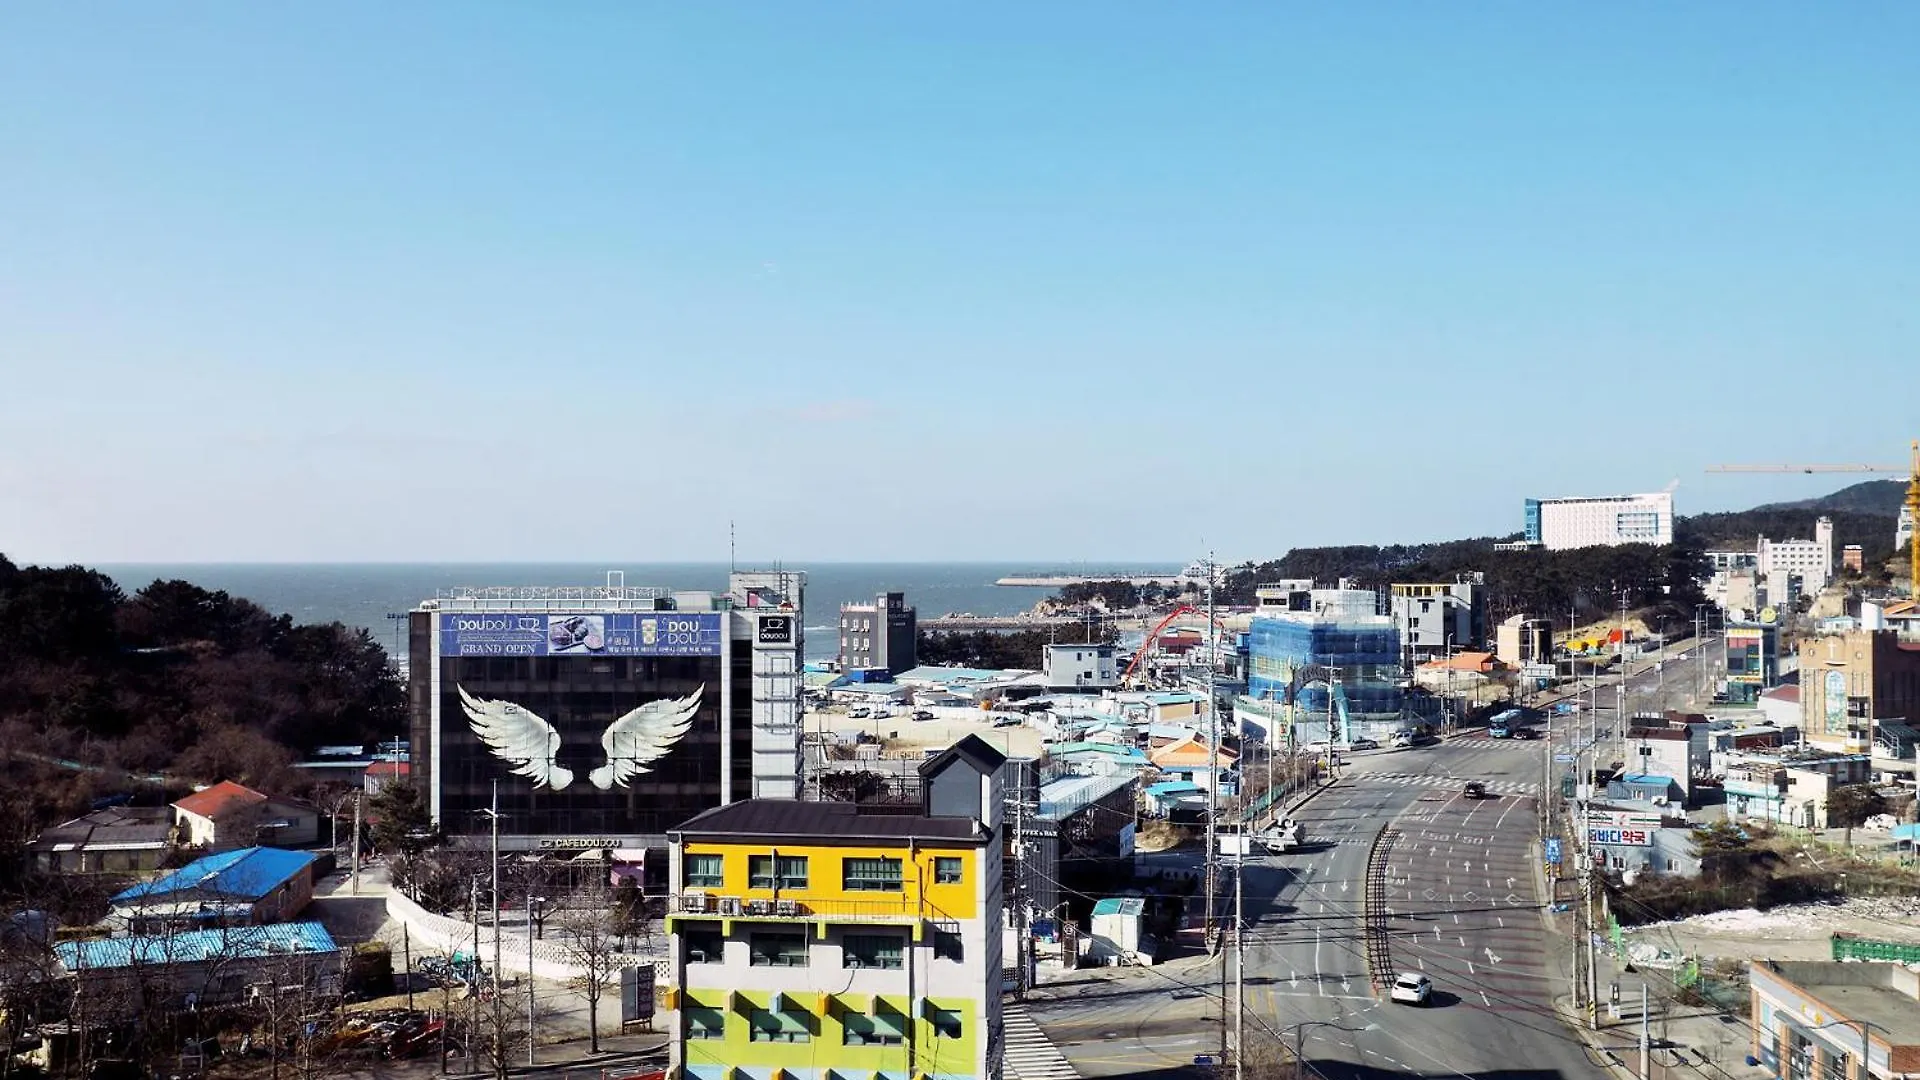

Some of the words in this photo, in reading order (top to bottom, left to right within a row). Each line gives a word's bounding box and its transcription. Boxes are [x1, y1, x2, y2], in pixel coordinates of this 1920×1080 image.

[458, 620, 512, 630] DOUDOU
[668, 621, 699, 632] DOU
[668, 633, 699, 644] DOU
[461, 643, 501, 654] GRAND
[506, 644, 535, 654] OPEN
